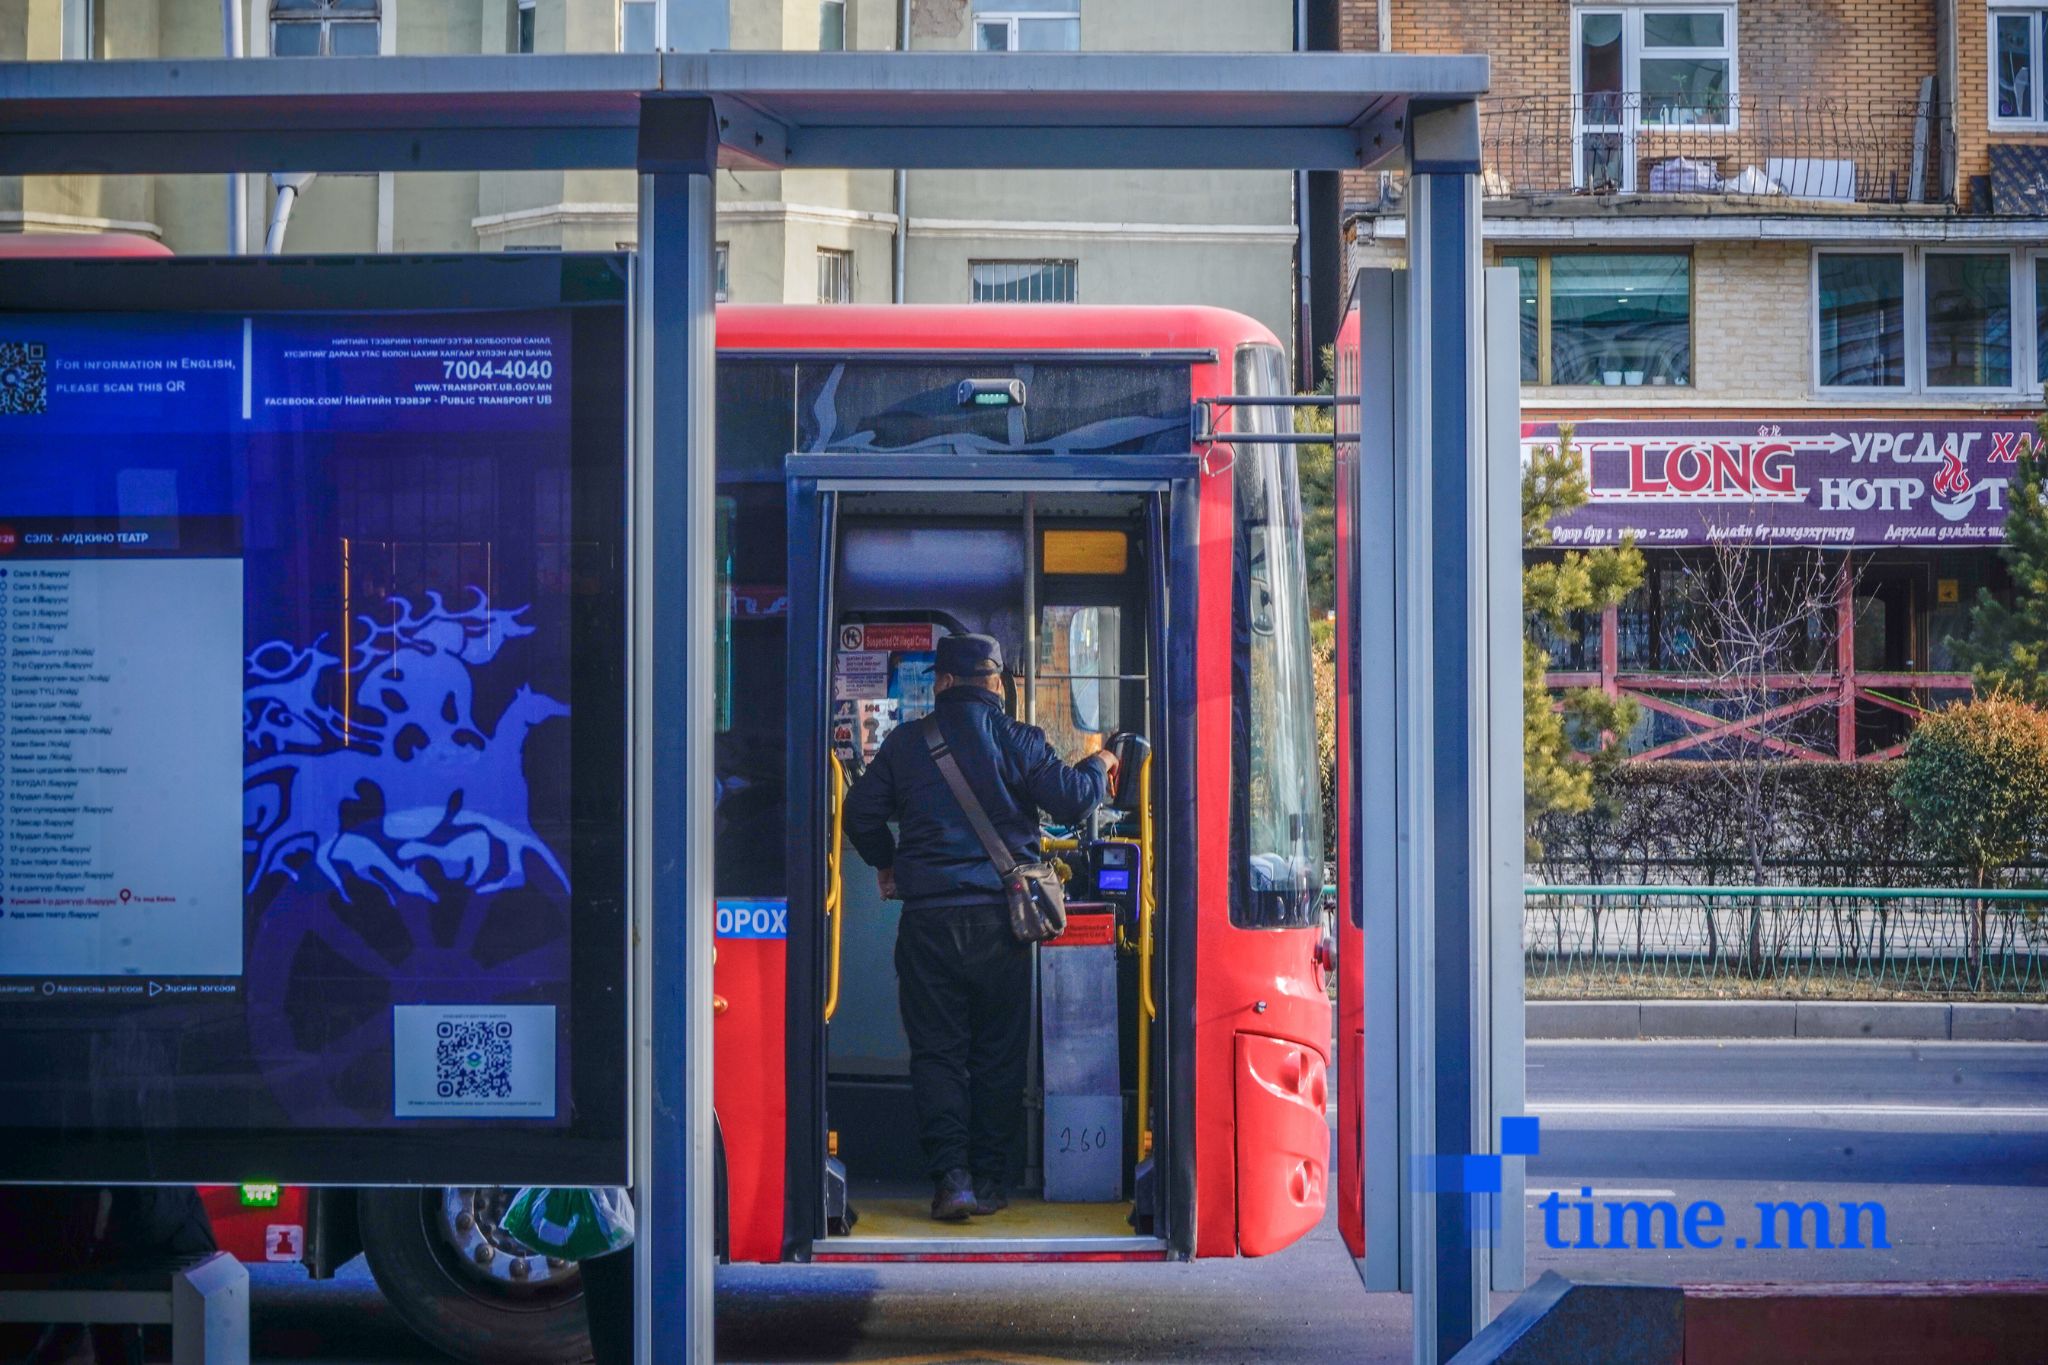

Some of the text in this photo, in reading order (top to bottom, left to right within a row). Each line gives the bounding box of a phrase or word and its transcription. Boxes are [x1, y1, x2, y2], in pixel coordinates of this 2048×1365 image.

[443, 361, 553, 379] 7004-4040
[166, 381, 186, 392] QR
[536, 395, 553, 405] UB
[1849, 432, 1982, 463] УРСДАГ
[1629, 442, 1797, 495] LONG
[62, 533, 84, 545] АРД
[85, 533, 114, 543] КИНО
[116, 532, 149, 543] ТЕАТР
[1658, 528, 1689, 539] 22:00
[717, 908, 787, 934] ОРОХ
[1060, 1126, 1106, 1153] 260
